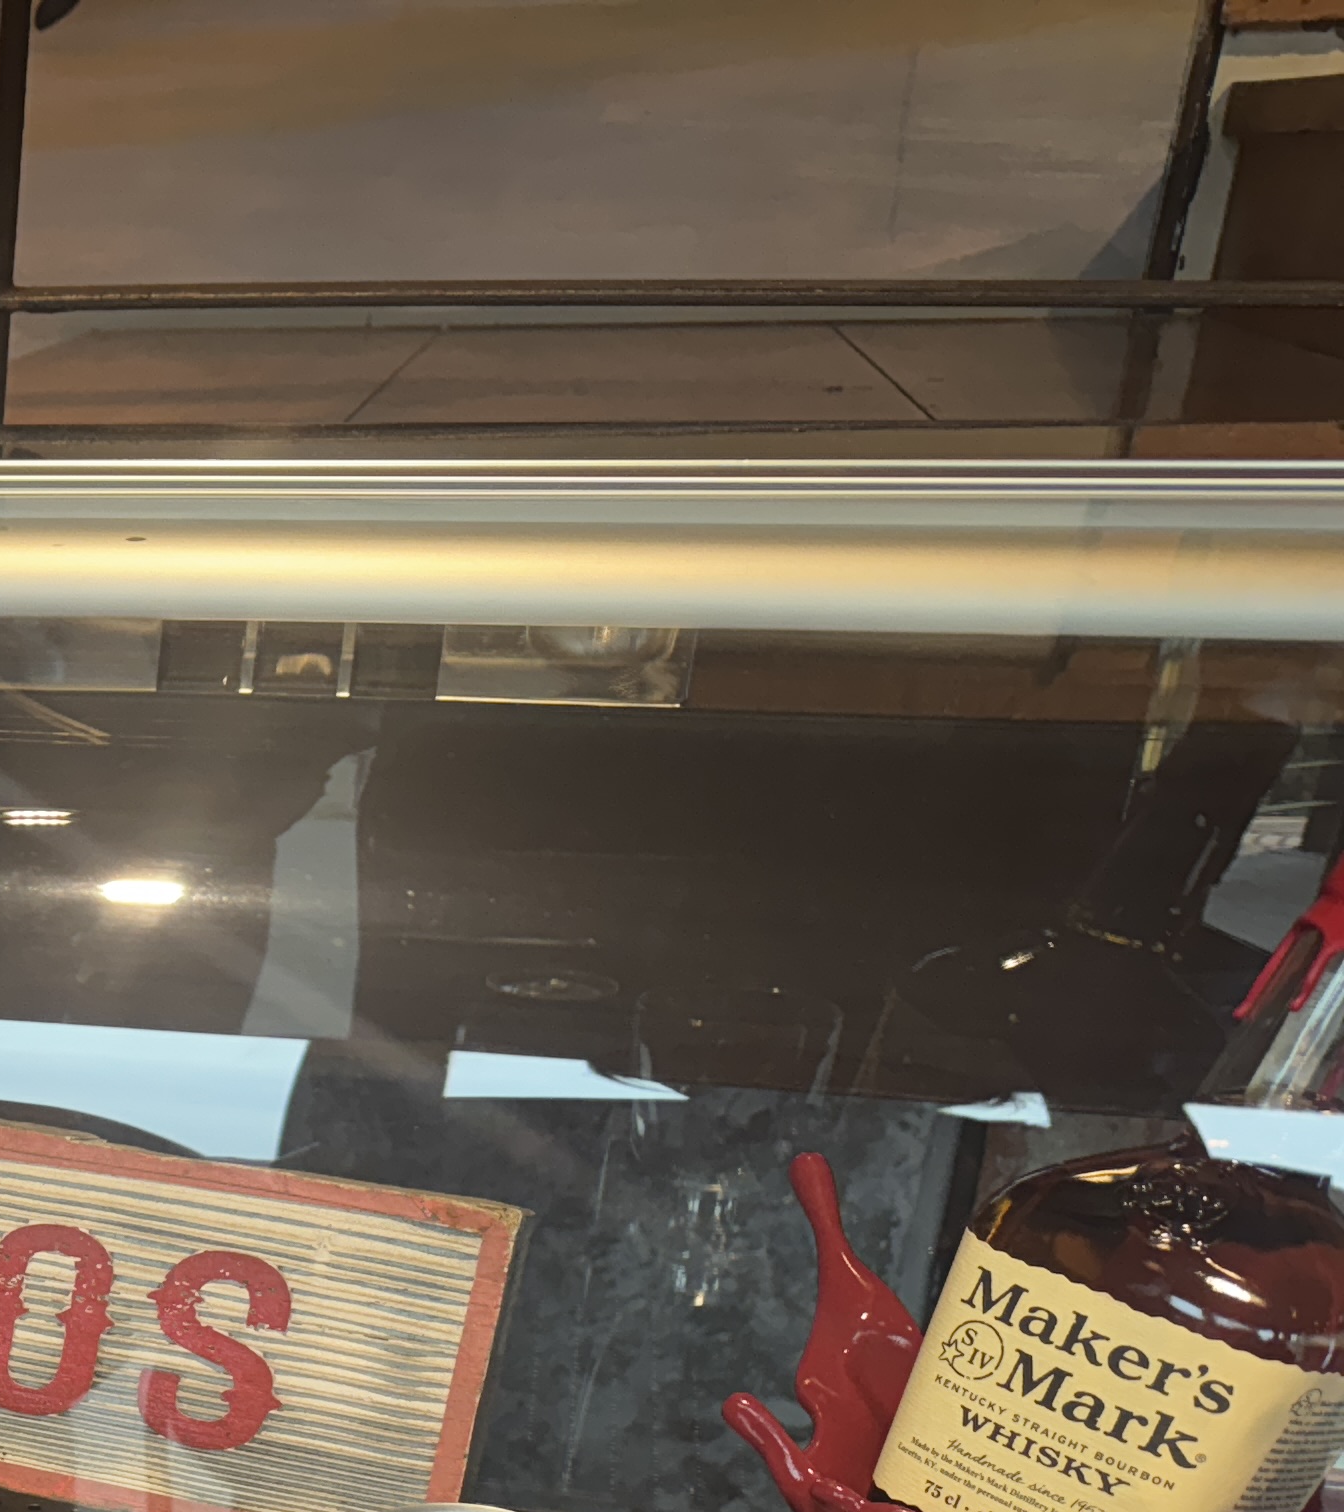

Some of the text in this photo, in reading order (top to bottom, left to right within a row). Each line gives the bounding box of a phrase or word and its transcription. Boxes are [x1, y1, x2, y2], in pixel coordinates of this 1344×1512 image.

[960, 1265, 1234, 1415] Maker's
[967, 1347, 994, 1370] IV
[934, 1373, 1175, 1490] KENTUCKY STRAIGHT BOURBON
[996, 1348, 1199, 1470] Mark
[911, 1436, 930, 1453] Made
[931, 1447, 939, 1458] by
[941, 1453, 953, 1465] the
[953, 1460, 984, 1481] Maker's
[986, 1476, 1008, 1493] Mark
[1009, 1488, 1048, 1512] Distillery
[939, 1468, 962, 1483] under
[963, 1479, 976, 1491] the
[976, 1486, 1012, 1508] personal
[947, 1438, 1025, 1485] Handmade
[1027, 1483, 1066, 1504] since
[960, 1404, 1131, 1496] WHISKY
[924, 1479, 944, 1498] 75
[944, 1494, 962, 1509] cl
